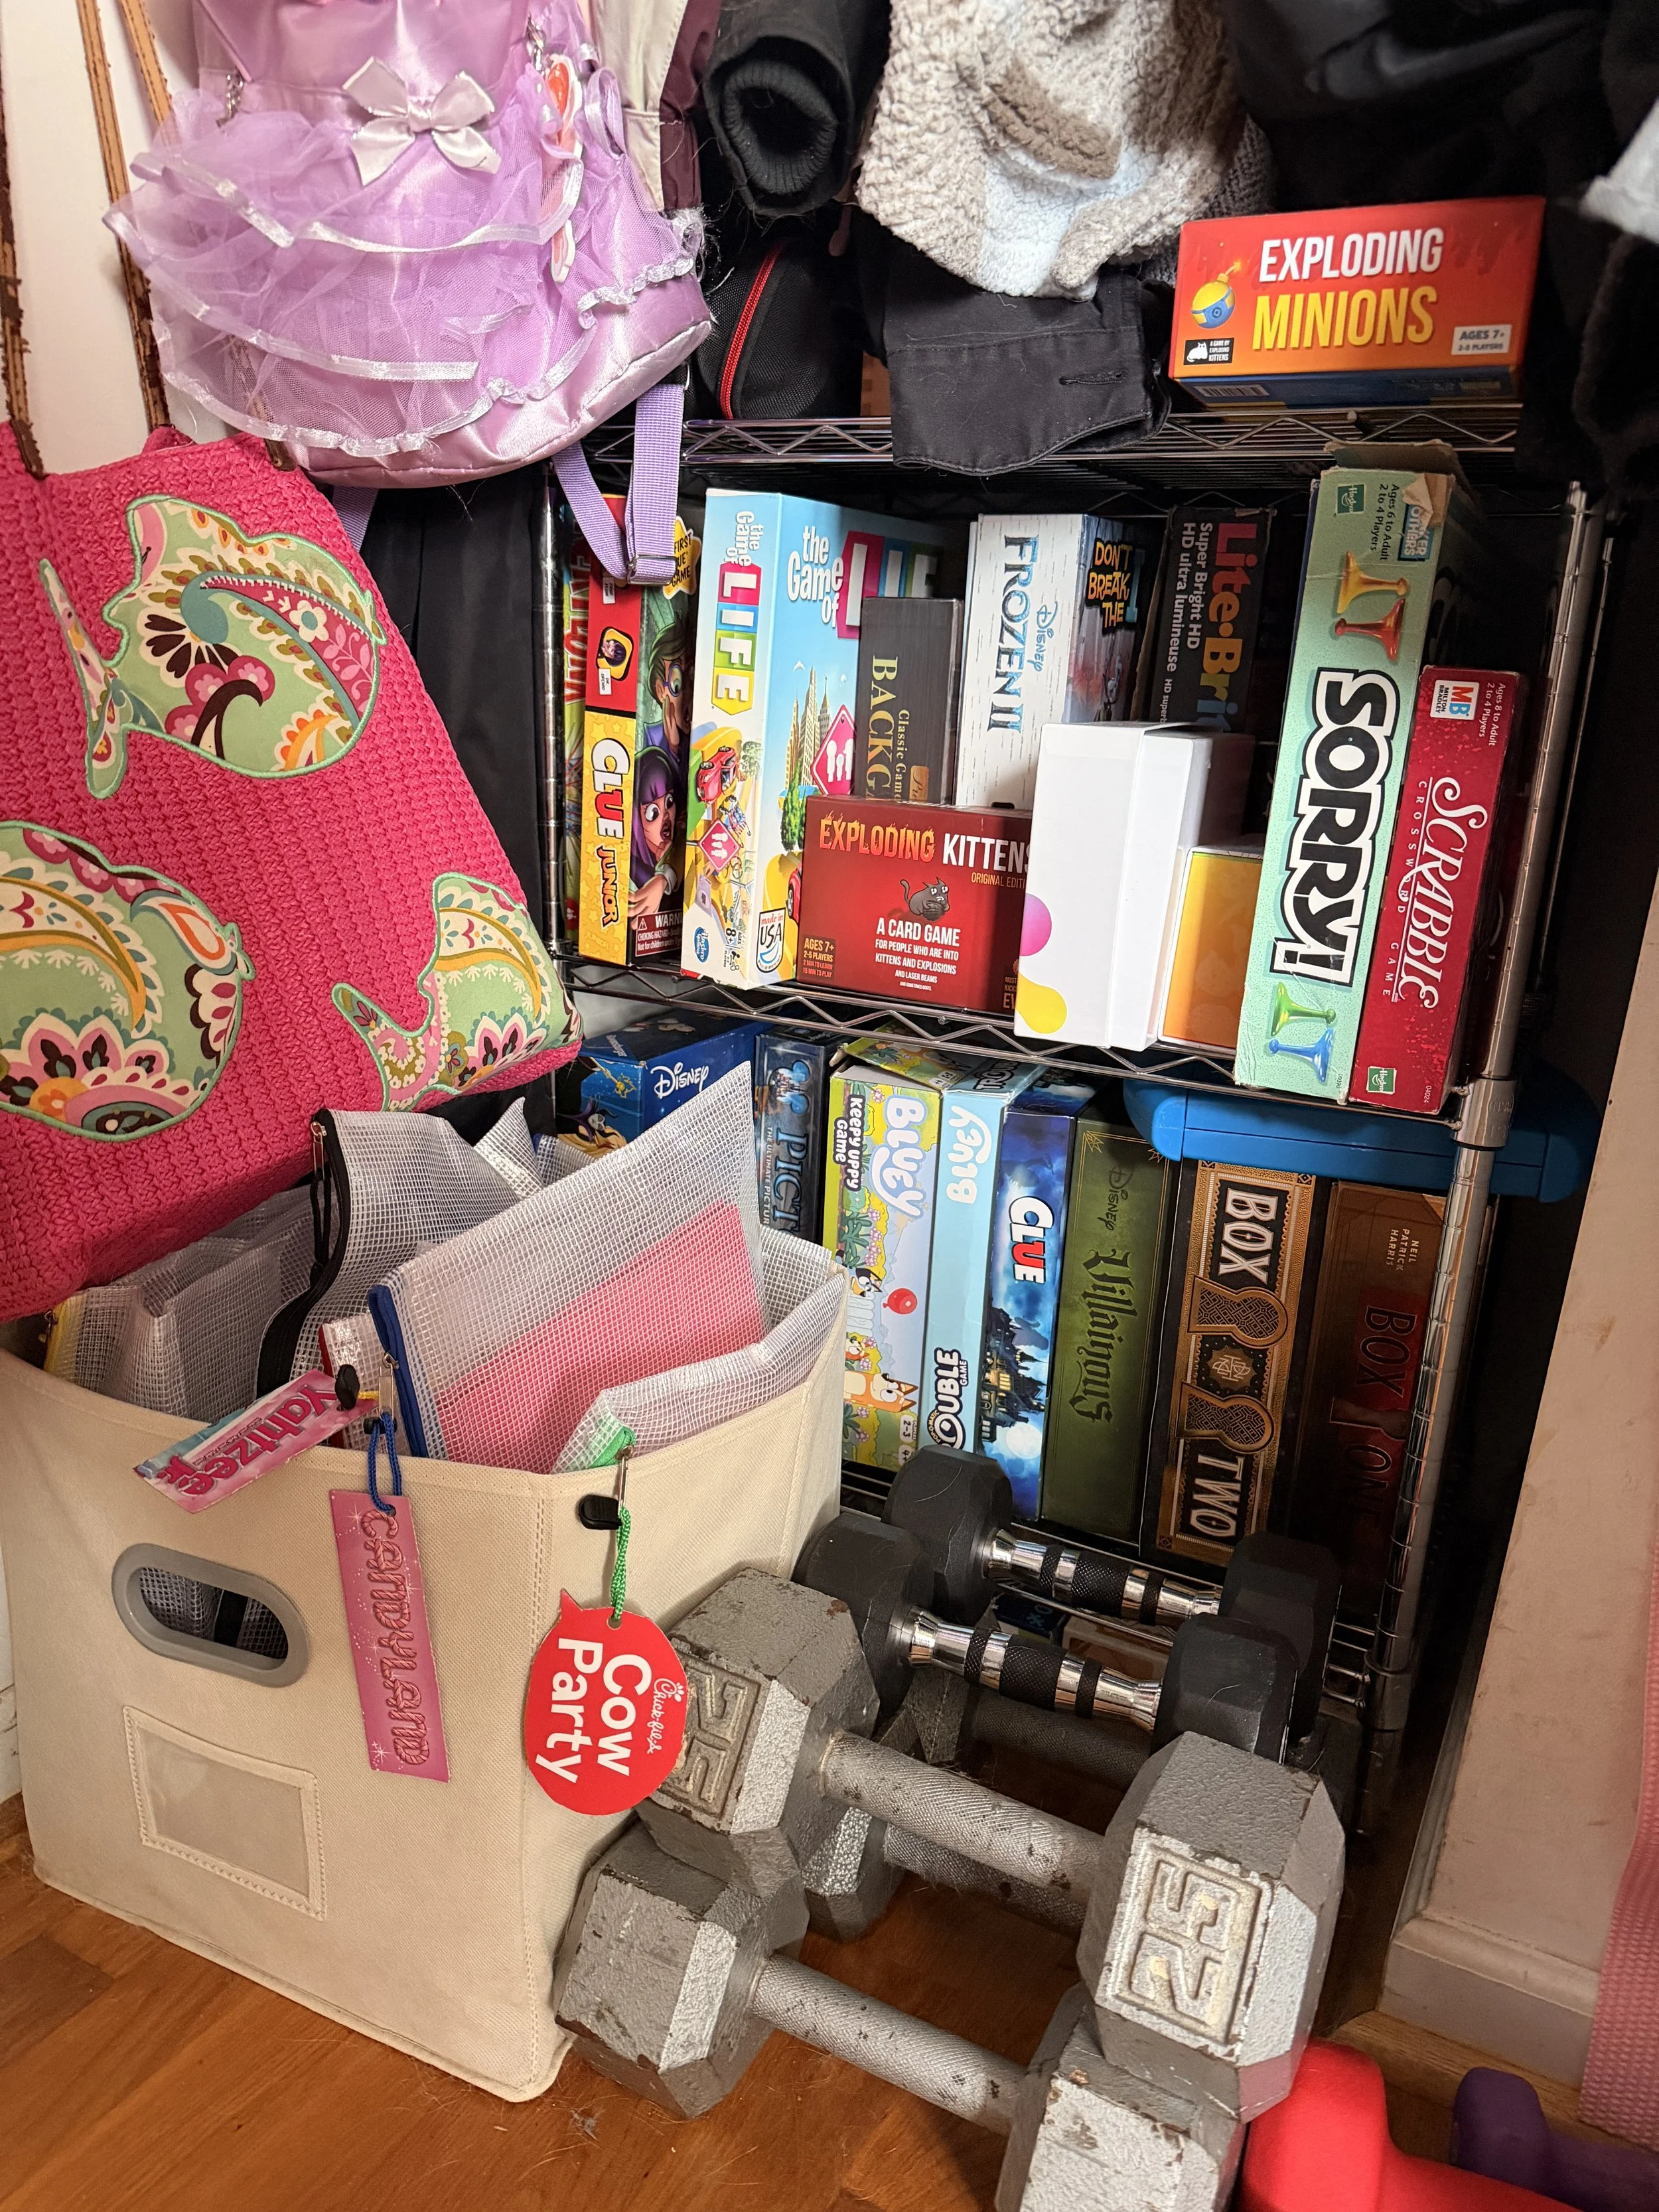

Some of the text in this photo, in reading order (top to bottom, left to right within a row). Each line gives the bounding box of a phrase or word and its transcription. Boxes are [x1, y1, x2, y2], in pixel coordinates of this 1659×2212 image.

[1259, 227, 1443, 282] EXPLODING
[1252, 286, 1437, 351] MINIONS
[1459, 329, 1505, 340] AGES 7+
[1378, 493, 1386, 503] to
[1388, 484, 1400, 509] Ages
[735, 511, 755, 567] Game
[749, 524, 764, 551] the
[1180, 523, 1196, 550] HD
[1370, 516, 1384, 551] Players
[1385, 522, 1394, 532] to
[674, 534, 691, 555] FIRST
[724, 547, 738, 565] of
[802, 525, 829, 565] the
[1095, 542, 1133, 571] DON'T
[1380, 534, 1392, 561] Adult
[788, 551, 843, 601] Game
[1088, 570, 1129, 600] BREAK
[1176, 551, 1192, 591] ultra
[1187, 522, 1213, 649] Super Bright HD
[822, 593, 839, 628] of
[993, 534, 1039, 699] FROZEN
[1101, 601, 1124, 628] THE
[717, 571, 757, 702] LIFE
[1027, 600, 1058, 672] Disney
[1167, 593, 1185, 672] lumineuse
[1164, 678, 1173, 694] HD
[1435, 685, 1445, 713] BRADLEY
[1441, 687, 1449, 712] MILTON
[1449, 686, 1474, 715] MB
[1485, 690, 1494, 699] to
[1495, 683, 1506, 703] Ages
[1479, 708, 1491, 737] Players
[1492, 713, 1501, 722] to
[897, 709, 910, 759] Classic
[1488, 723, 1499, 747] Adult
[591, 737, 630, 927] CLUE JUNIOR
[819, 811, 936, 863] EXPLODING
[1269, 666, 1400, 987] SORRY!
[971, 872, 1005, 887] ORIGINAL
[1382, 780, 1427, 996] CROSSWORD GAME
[1398, 776, 1488, 1009] SCRABBLE
[761, 913, 783, 925] made in
[876, 917, 961, 947] A CARD GAME
[638, 930, 654, 942] CHOKING
[650, 939, 664, 949] children
[725, 928, 737, 944] 8+
[760, 922, 782, 949] USA
[804, 938, 835, 952] AGES 7+
[875, 938, 959, 961] FOR PEOPLE WHO ARE INTO
[803, 950, 833, 962] 2-5 PLAYERS
[820, 962, 833, 970] LEARN
[875, 952, 957, 975] KITTENS AND EXPLOSIONS
[895, 970, 938, 984] AND LASER BEAMS
[650, 1061, 709, 1099] Disney
[1423, 1085, 1432, 1103] 04024
[1096, 1165, 1133, 1231] Disney
[1009, 1196, 1054, 1284] CLUE
[1218, 1188, 1279, 1284] BOX
[1386, 1228, 1396, 1267] HARRIS
[1396, 1228, 1411, 1272] PATRICK
[1408, 1239, 1419, 1263] NEIL
[1067, 1248, 1138, 1424] Villainous
[1356, 1305, 1418, 1398] BOX
[178, 1384, 338, 1495] Yahtzee
[902, 1420, 911, 1438] 2-3
[157, 1455, 195, 1485] Jr.
[1188, 1453, 1246, 1538] TWO
[360, 1509, 430, 1765] CANDYLAND
[536, 1638, 603, 1784] Party
[597, 1654, 652, 1777] Cow
[1129, 1860, 1239, 2026] 25
